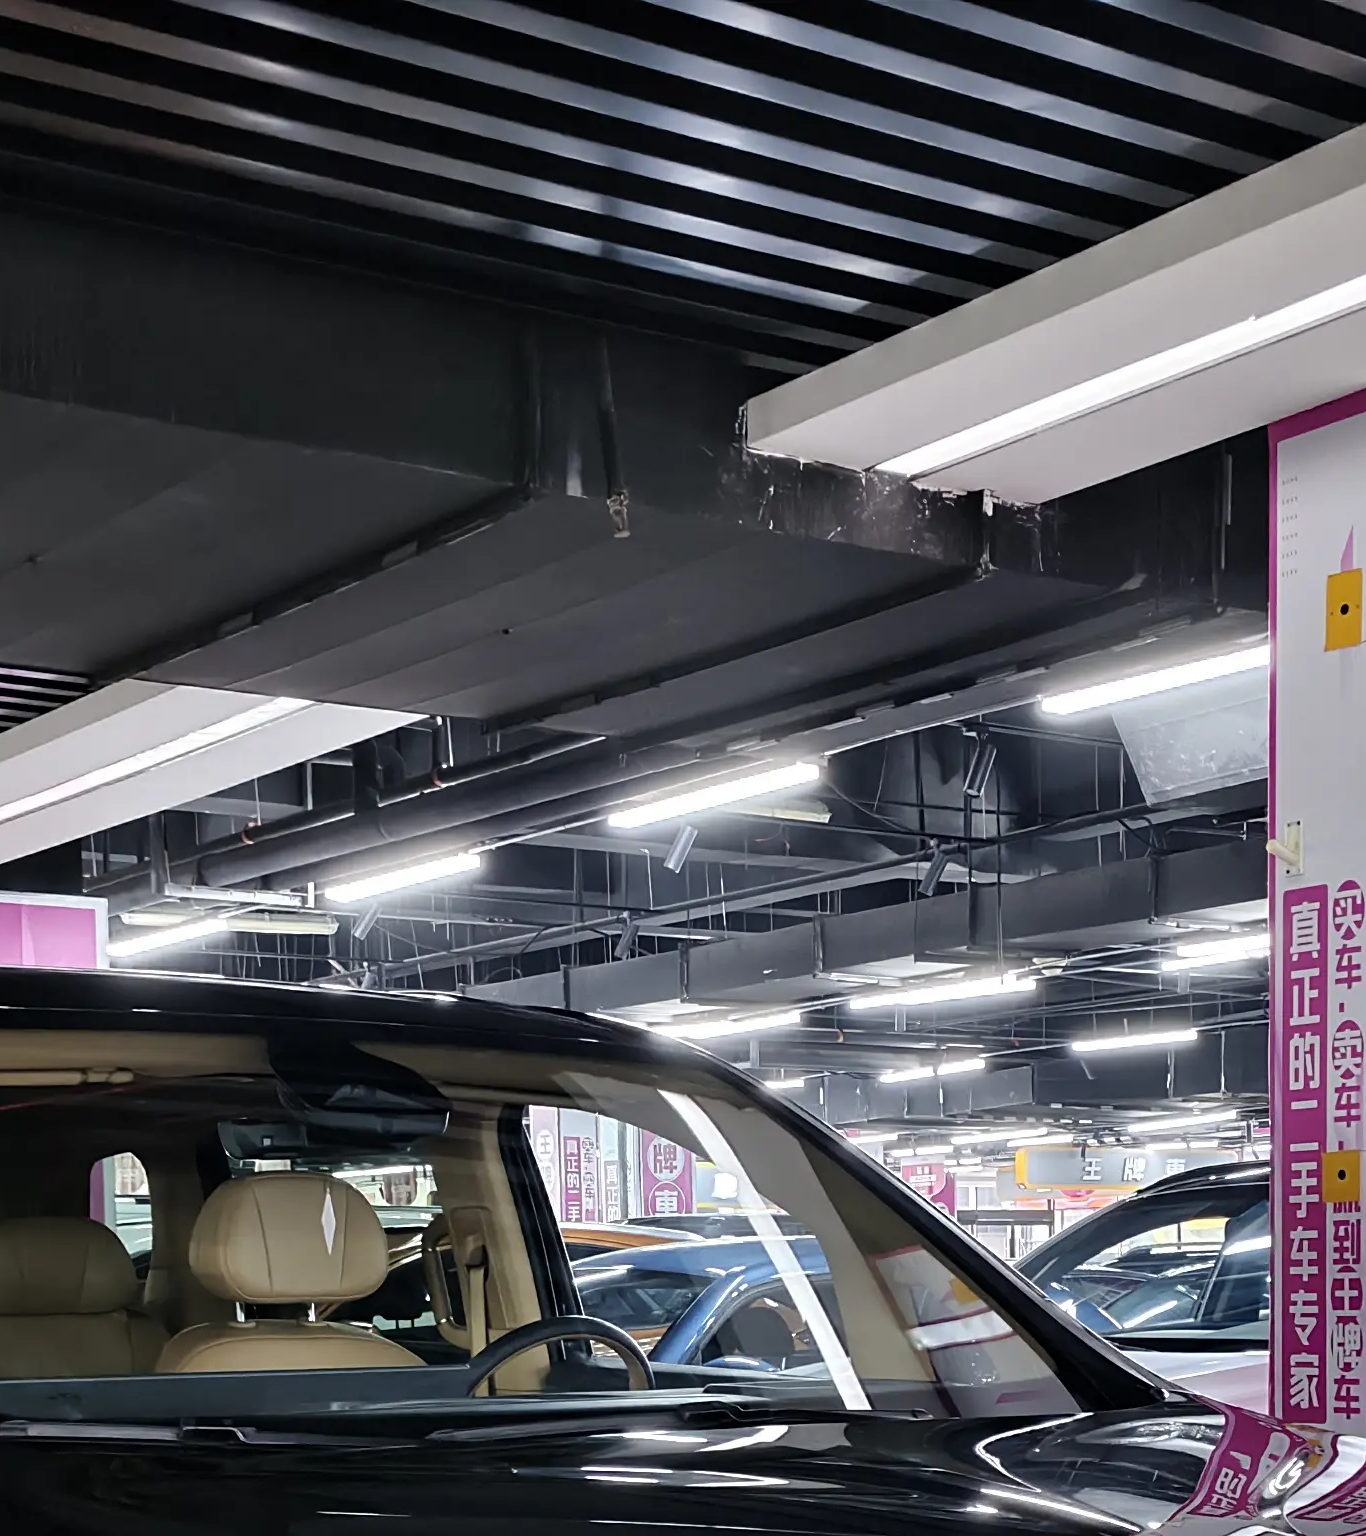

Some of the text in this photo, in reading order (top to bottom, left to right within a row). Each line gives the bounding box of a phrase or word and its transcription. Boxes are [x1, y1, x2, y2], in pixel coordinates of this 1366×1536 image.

[1288, 900, 1321, 1411] 真正的二手车专家
[1332, 881, 1365, 1421] 买车·卖车·到王牌车
